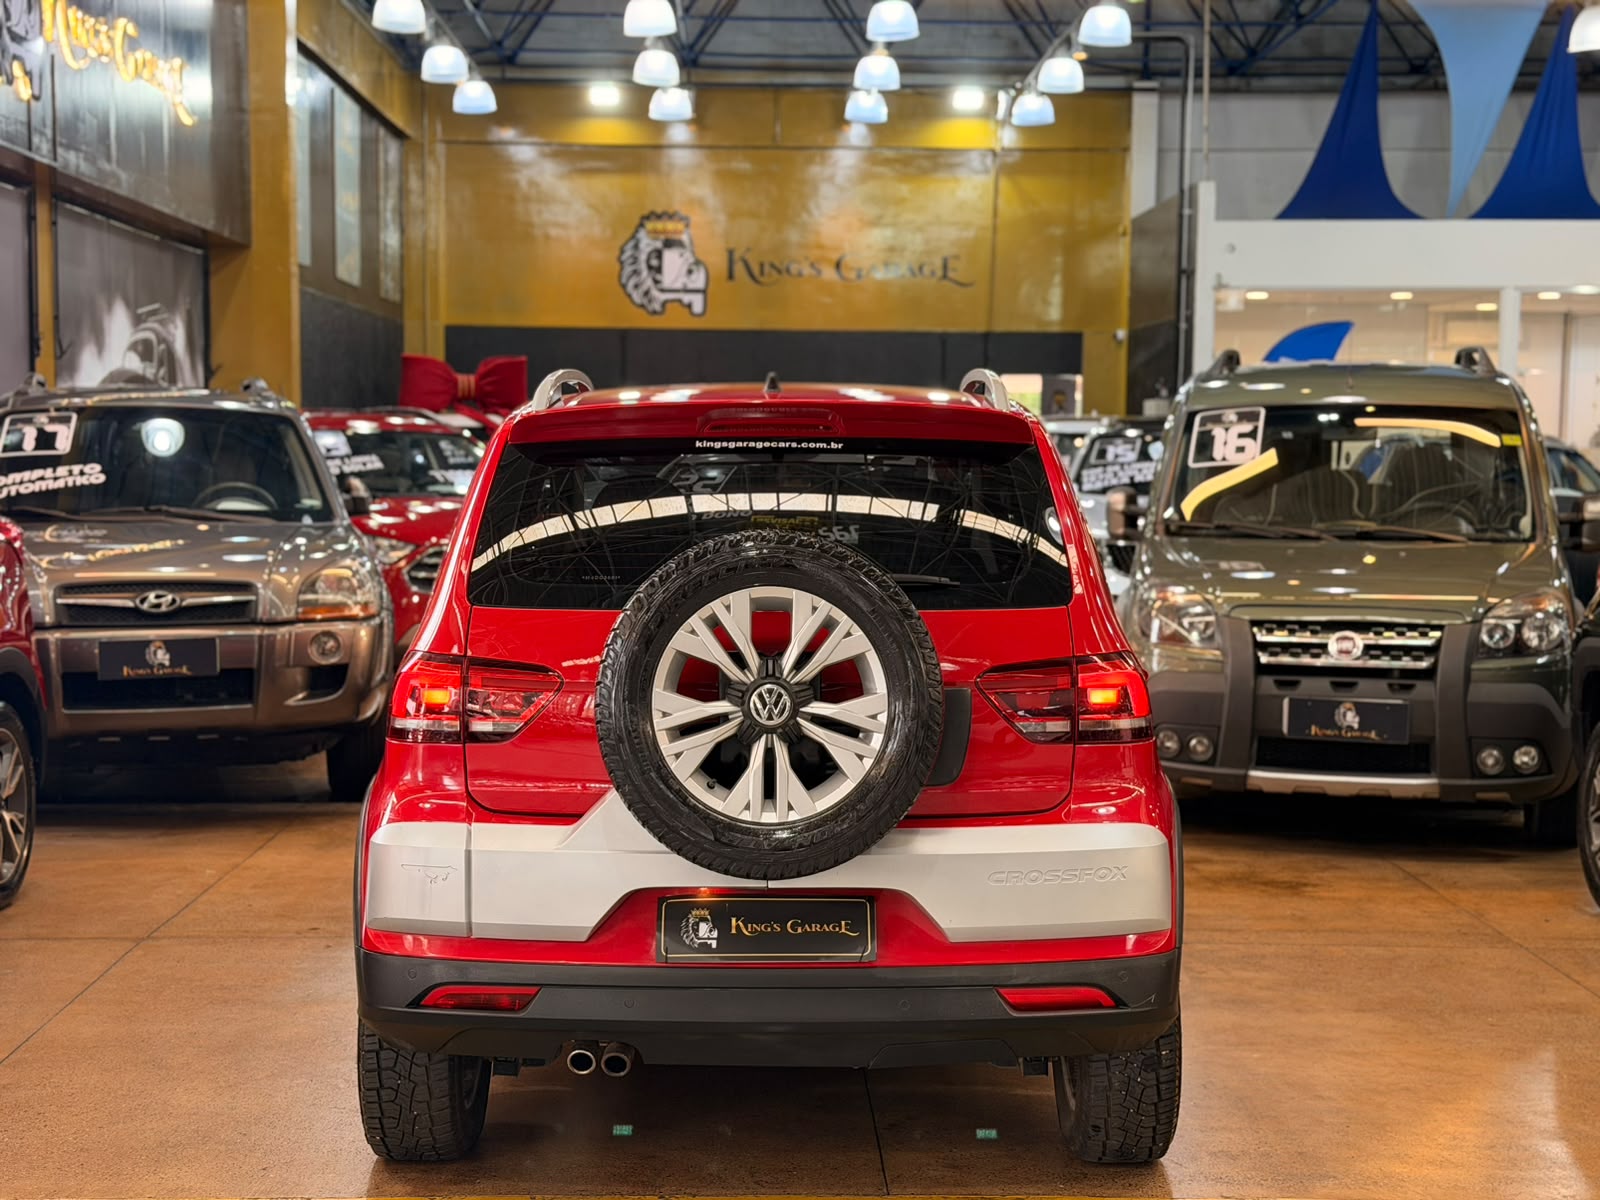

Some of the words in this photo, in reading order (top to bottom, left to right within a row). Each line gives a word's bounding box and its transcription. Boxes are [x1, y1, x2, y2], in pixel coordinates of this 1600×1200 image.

[725, 247, 824, 287] KING'S
[834, 252, 975, 288] GARAGE
[695, 439, 844, 449] kingsgaragecars.com.br
[1211, 423, 1258, 462] 16
[0, 462, 102, 487] OMPLETO
[987, 865, 1129, 886] CROSSFOX
[729, 916, 781, 936] KING'S
[786, 918, 860, 936] GARAGE
